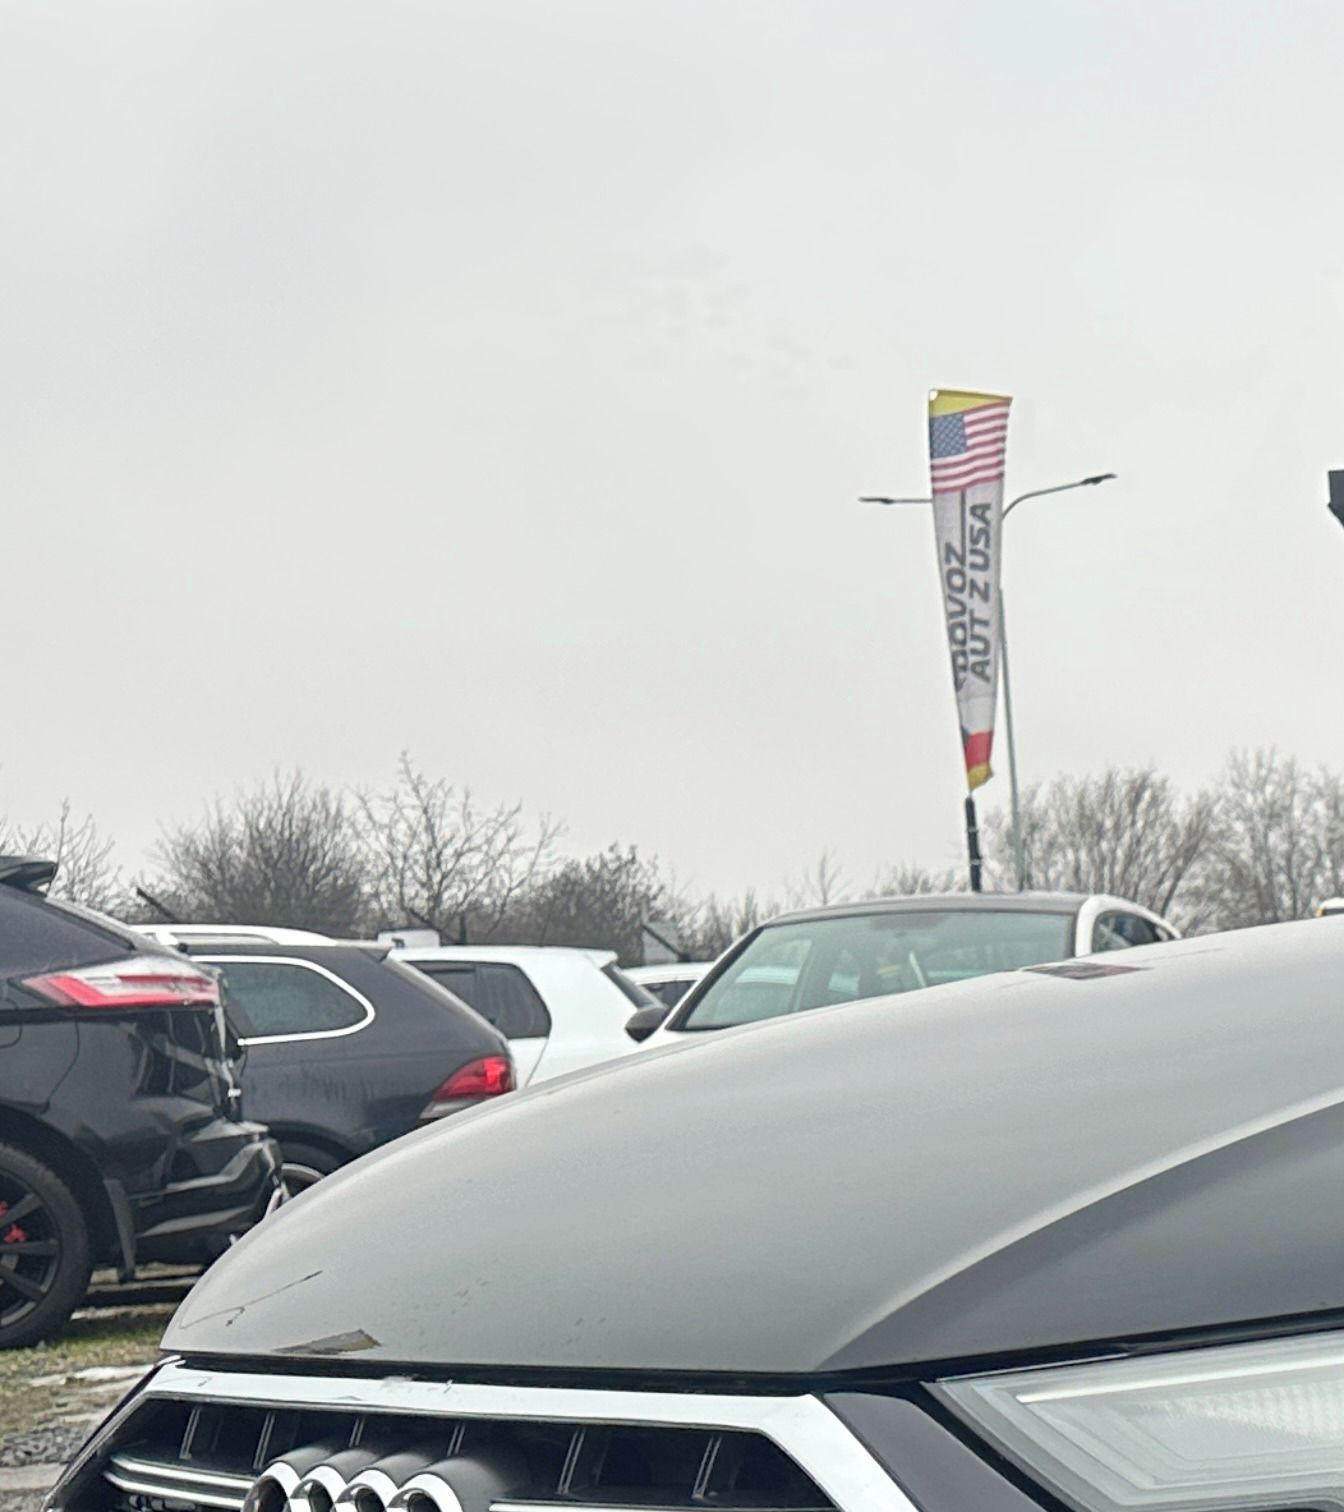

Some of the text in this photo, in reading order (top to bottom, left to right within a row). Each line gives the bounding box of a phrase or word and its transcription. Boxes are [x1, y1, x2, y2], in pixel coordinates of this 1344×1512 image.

[969, 502, 991, 683] AUT Z USA
